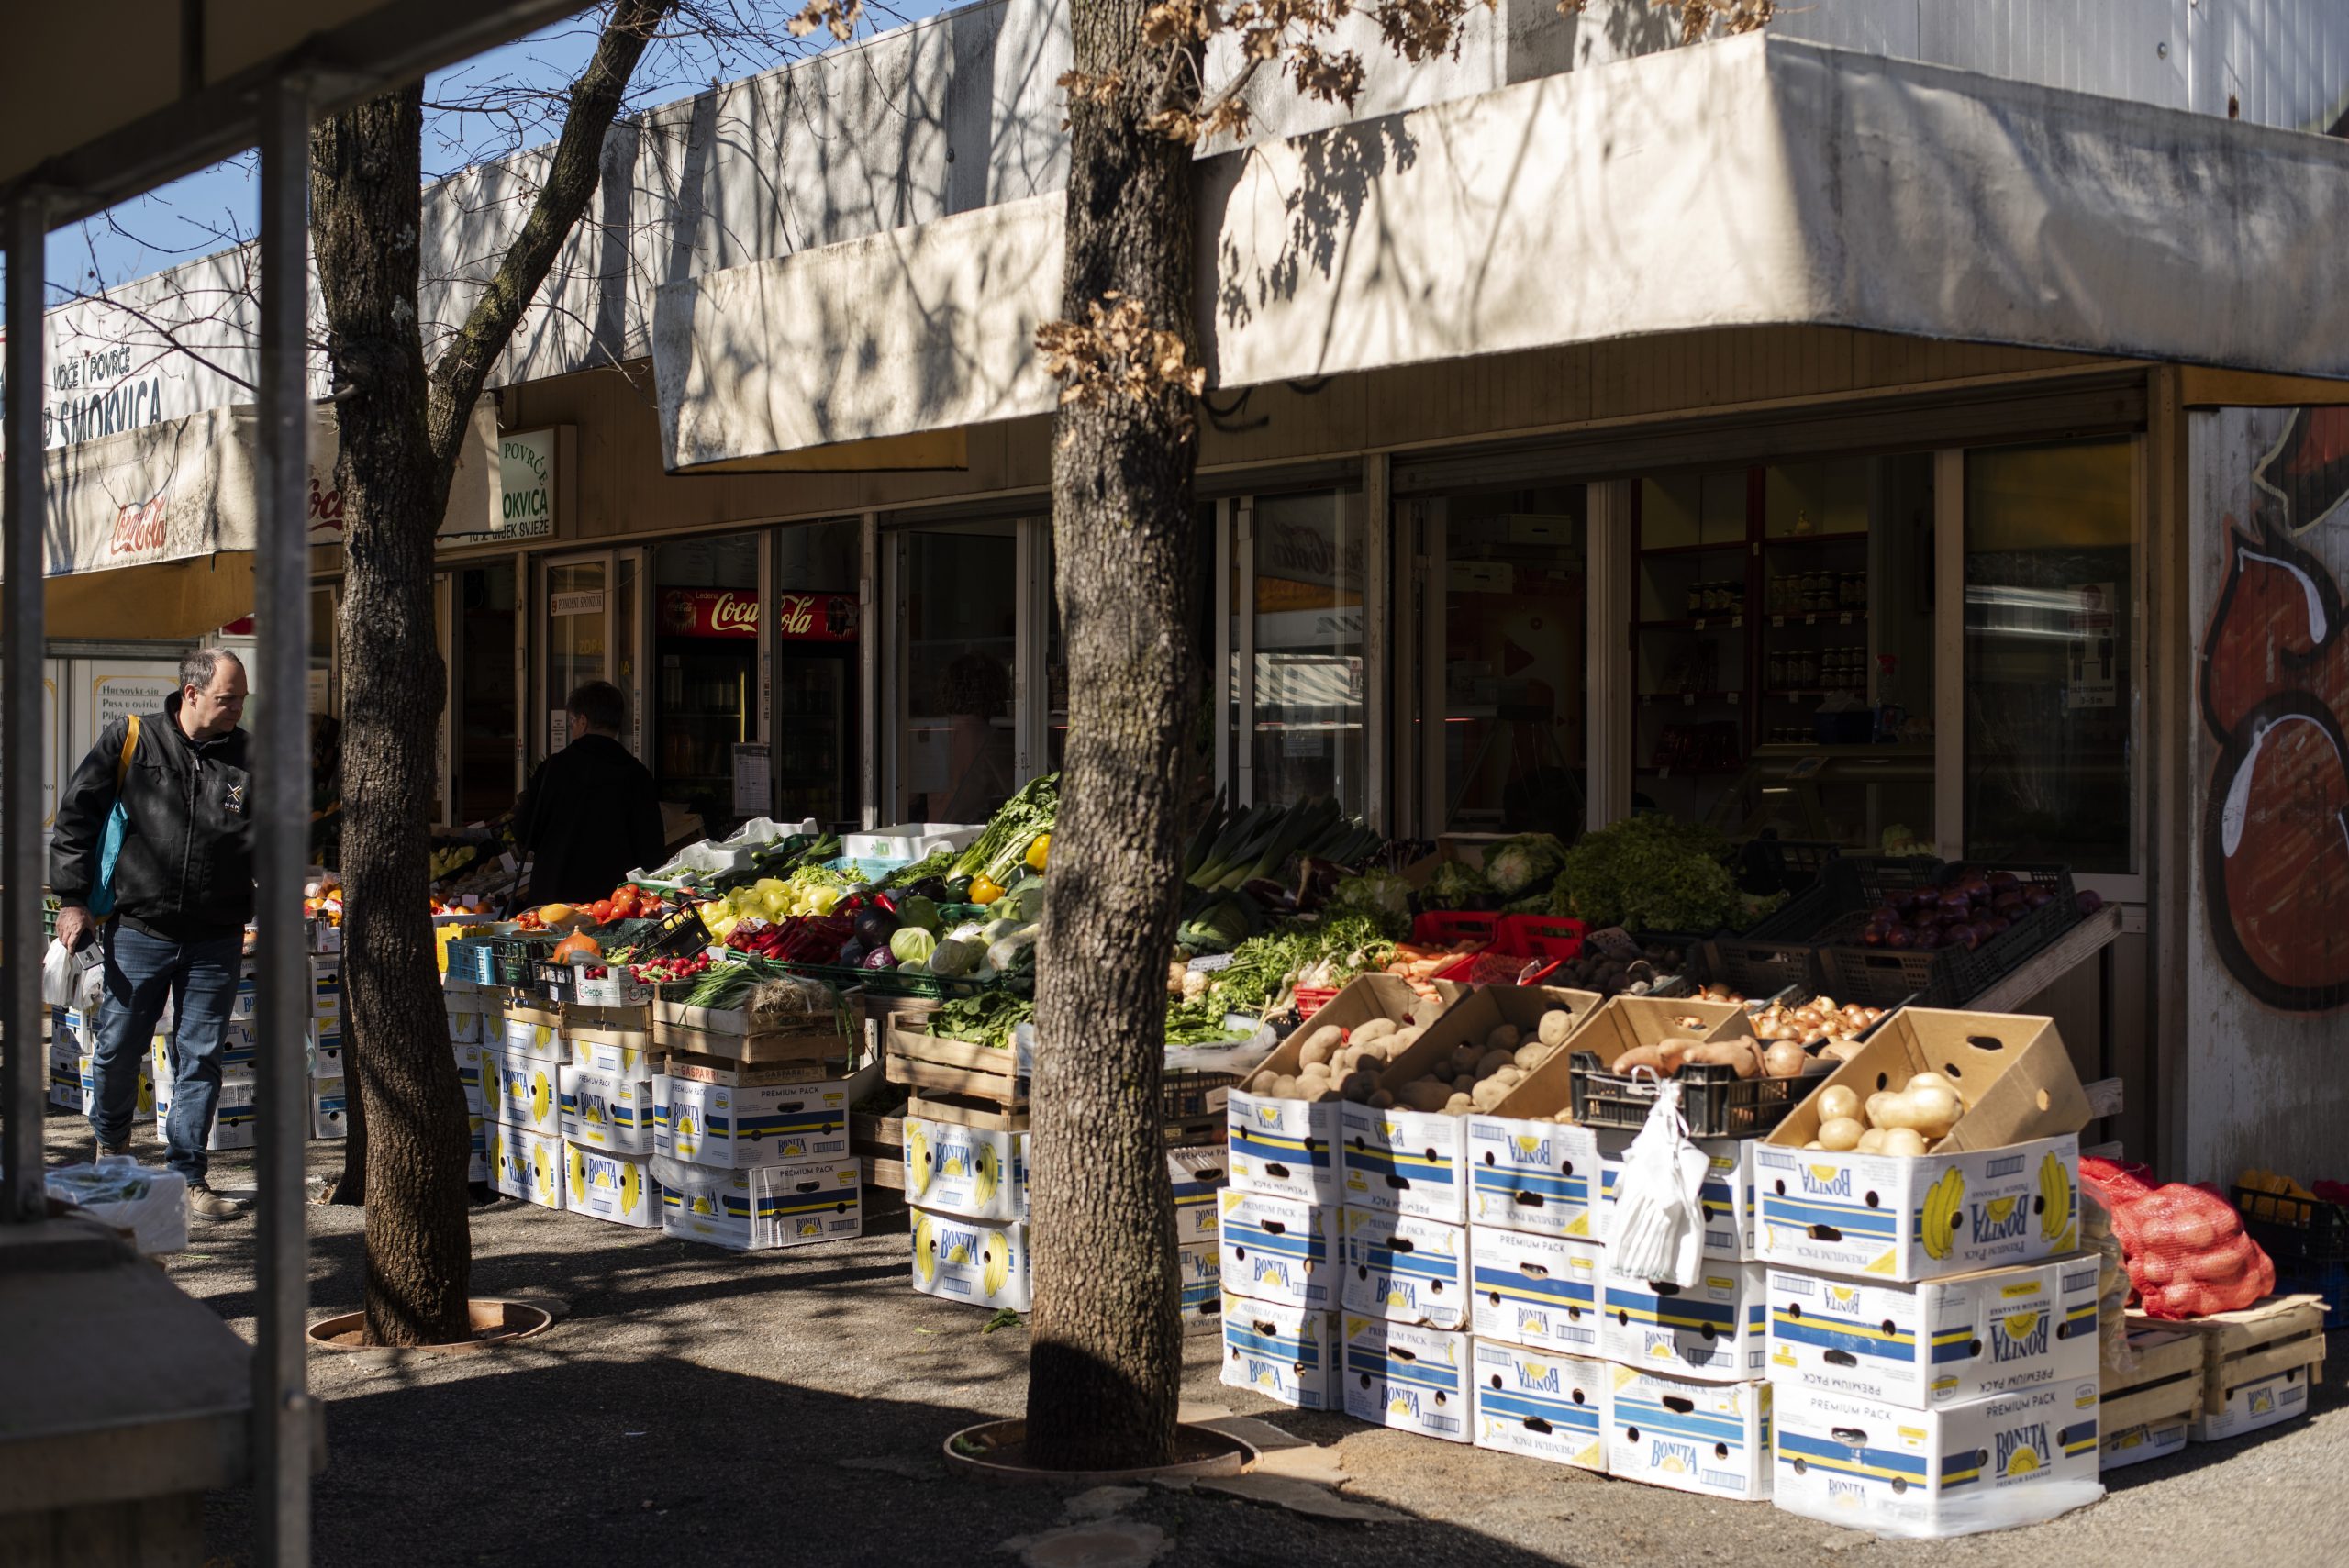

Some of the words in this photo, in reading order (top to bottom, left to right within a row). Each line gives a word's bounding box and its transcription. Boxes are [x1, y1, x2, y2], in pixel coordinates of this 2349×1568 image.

[504, 442, 549, 486] POVRĆE
[503, 488, 548, 519] OKVICA
[519, 517, 550, 537] SVJEŽE
[502, 1069, 530, 1099] BONITA
[681, 1066, 719, 1082] GASPARRI
[761, 1088, 797, 1097] PREMIUM
[799, 1086, 819, 1095] PACK
[581, 1092, 607, 1121] BONITA
[674, 1102, 701, 1132] BONITA
[777, 1138, 807, 1153] BONITA
[1175, 1149, 1214, 1161] PREMIUM
[1507, 1135, 1551, 1166] BONITA
[780, 1168, 813, 1177] PREMIUM
[816, 1165, 834, 1173] PACK
[935, 1142, 973, 1178] BONITA
[588, 1158, 618, 1189] BONITA
[1798, 1163, 1852, 1197] BONITA
[1196, 1208, 1219, 1228] BONIT
[1242, 1201, 1275, 1214] PREMIUM
[1276, 1207, 1297, 1218] PACK
[1970, 1194, 2030, 1244] BONITA
[796, 1217, 823, 1234] BONITA
[1406, 1226, 1427, 1237] PACK
[940, 1229, 980, 1266] BONITA
[1500, 1235, 1540, 1249] PREMIUM
[1542, 1241, 1565, 1253] PACK
[1796, 1246, 1820, 1258] PACK
[1194, 1255, 1221, 1278] NITA
[1820, 1252, 1869, 1266] PREMIUM
[1253, 1256, 1291, 1288] BONITA
[1376, 1277, 1417, 1309] BONITA
[1824, 1287, 1861, 1315] BONITA
[1517, 1307, 1550, 1333] BONITA
[1368, 1326, 1405, 1341] PREMIUM
[1407, 1333, 1428, 1345] PACK
[1989, 1315, 2051, 1363] BONITA
[1248, 1359, 1283, 1391] BONITA
[1514, 1361, 1560, 1394] BONITA
[1802, 1373, 1830, 1386] PACK
[1832, 1378, 1882, 1396] PREMIUM
[1979, 1380, 2005, 1394] PACK
[2008, 1368, 2054, 1386] PREMIUM
[1379, 1384, 1420, 1418] BONITA
[1810, 1397, 1861, 1416] PREMIUM
[1864, 1407, 1893, 1421] PACK
[1986, 1399, 2031, 1418] PREMIUM
[2032, 1392, 2056, 1407] PACK
[1512, 1435, 1533, 1447] PACK
[1534, 1440, 1575, 1456] PREMIUM
[1995, 1422, 2052, 1473] BONITA
[1652, 1440, 1699, 1476] BONITA
